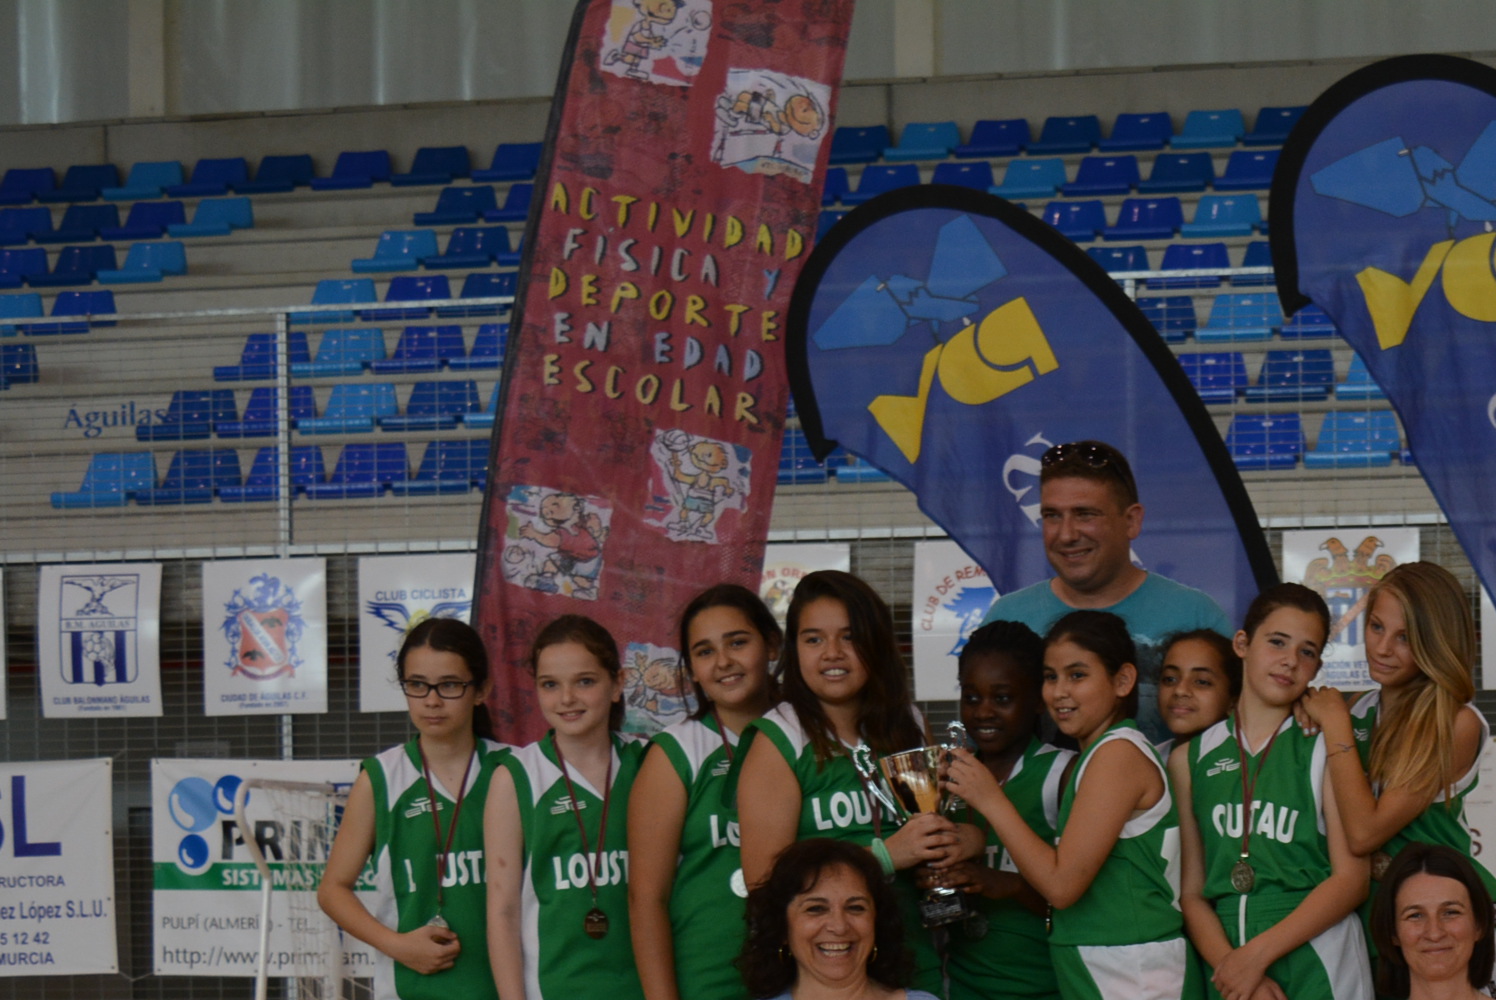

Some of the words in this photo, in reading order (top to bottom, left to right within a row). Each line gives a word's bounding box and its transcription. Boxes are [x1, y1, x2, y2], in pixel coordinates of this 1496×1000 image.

[551, 182, 803, 261] ACTIVIDAD
[563, 227, 719, 287] FÍSICA
[763, 268, 781, 300] Y
[549, 267, 779, 341] DEPORTE
[554, 312, 610, 352] EN
[654, 332, 764, 382] EDAD
[543, 354, 759, 425] ESCOLAR
[65, 402, 169, 438] Águilas
[375, 590, 407, 601] CLUB
[411, 588, 467, 600] CICLISTA
[222, 868, 316, 886] SISTMAS
[20, 902, 62, 924] López
[66, 900, 108, 918] S.L.U.
[162, 912, 200, 930] PULPÍ
[13, 932, 28, 945] 12
[33, 931, 50, 945] 42
